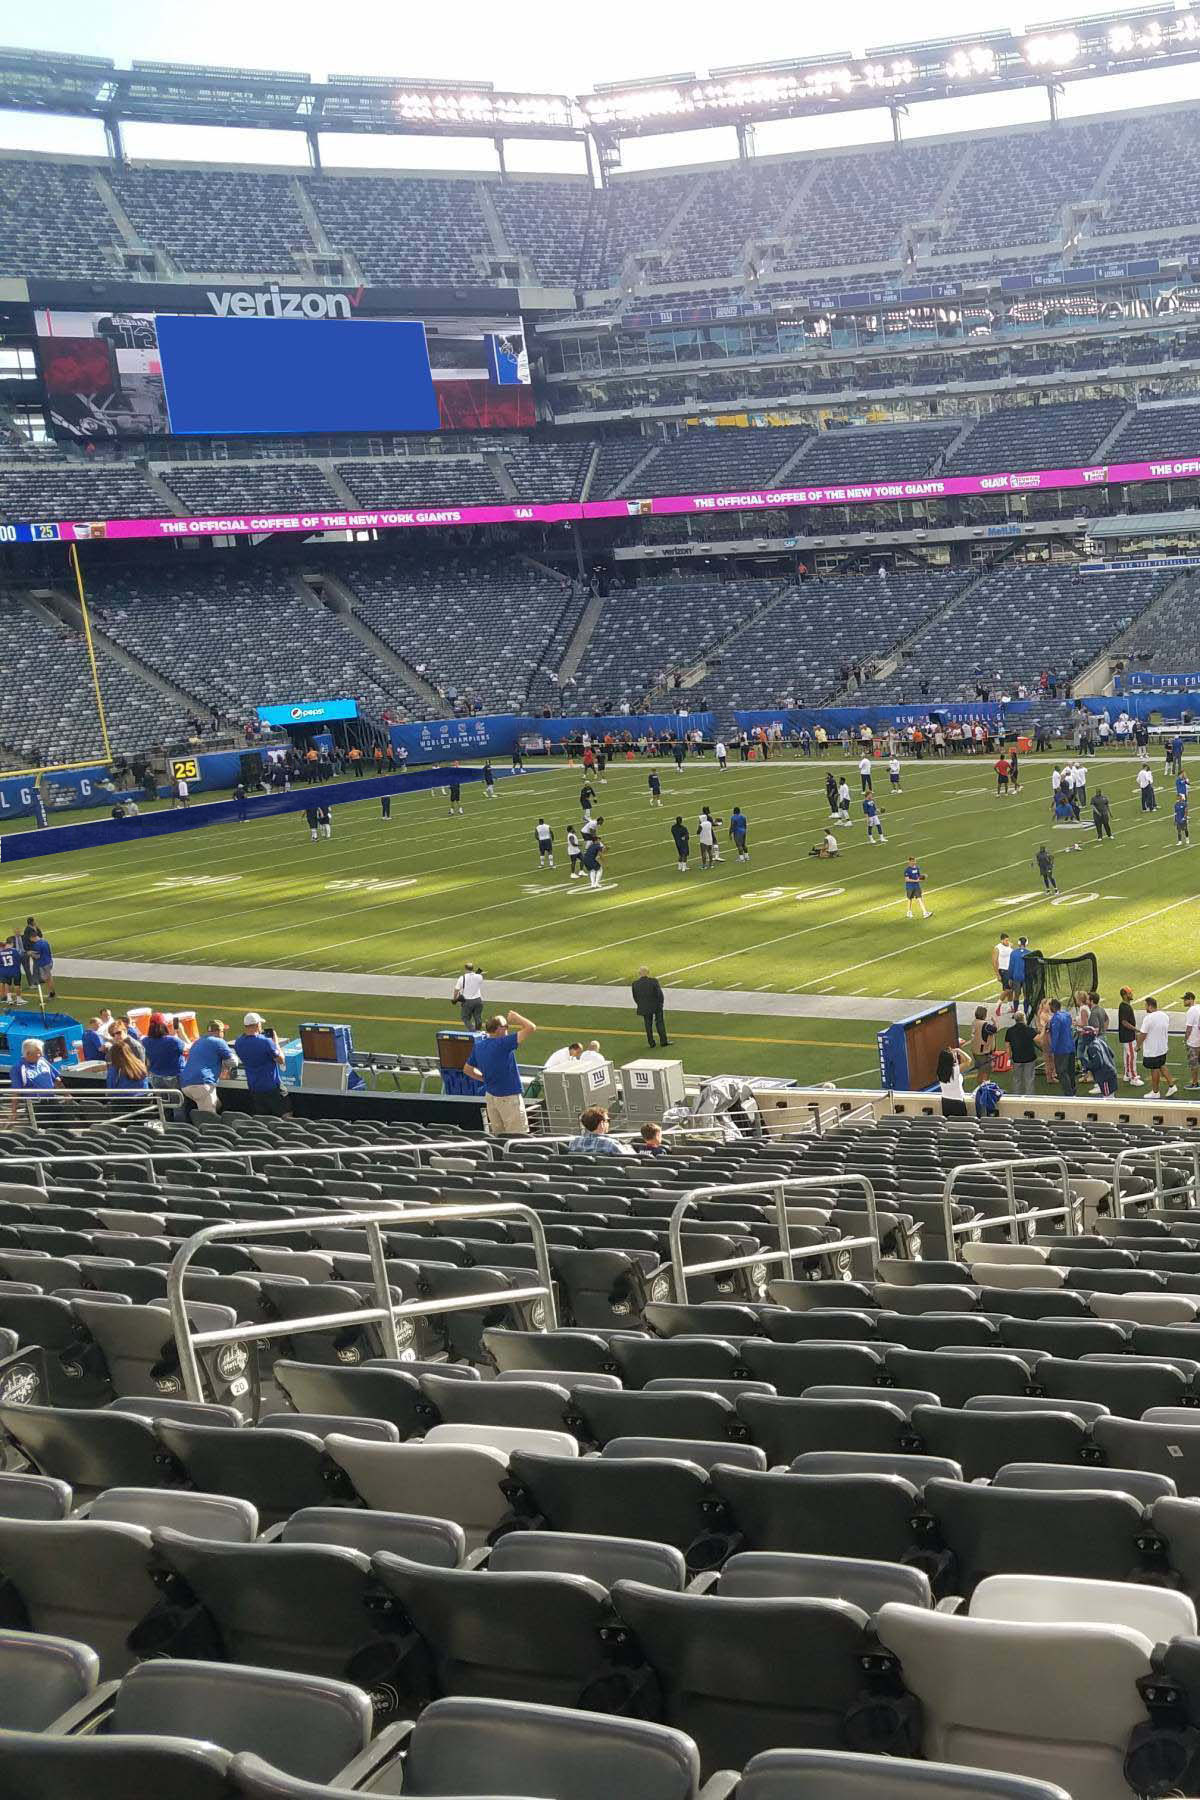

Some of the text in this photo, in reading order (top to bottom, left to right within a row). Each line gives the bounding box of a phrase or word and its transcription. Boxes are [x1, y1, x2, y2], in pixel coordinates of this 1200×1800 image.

[206, 286, 351, 318] verizon
[1150, 464, 1172, 476] THE
[694, 483, 944, 508] THE OFFICIAL COFFEE OF THE NEW YORK GIANTS
[160, 511, 461, 533] THE OFFICIAL COFFEE OF THE NEW YORK GIANTS
[39, 526, 53, 538] 25
[988, 527, 1021, 536] MetLife
[662, 547, 692, 556] verizon
[302, 708, 325, 717] pepsi
[420, 739, 445, 747] WORLD
[174, 762, 196, 779] 25
[80, 779, 92, 796] G
[1, 788, 31, 808] L G
[740, 886, 846, 899] 50
[994, 891, 1099, 907] 40
[3, 955, 14, 967] 13
[234, 1380, 245, 1394] 20
